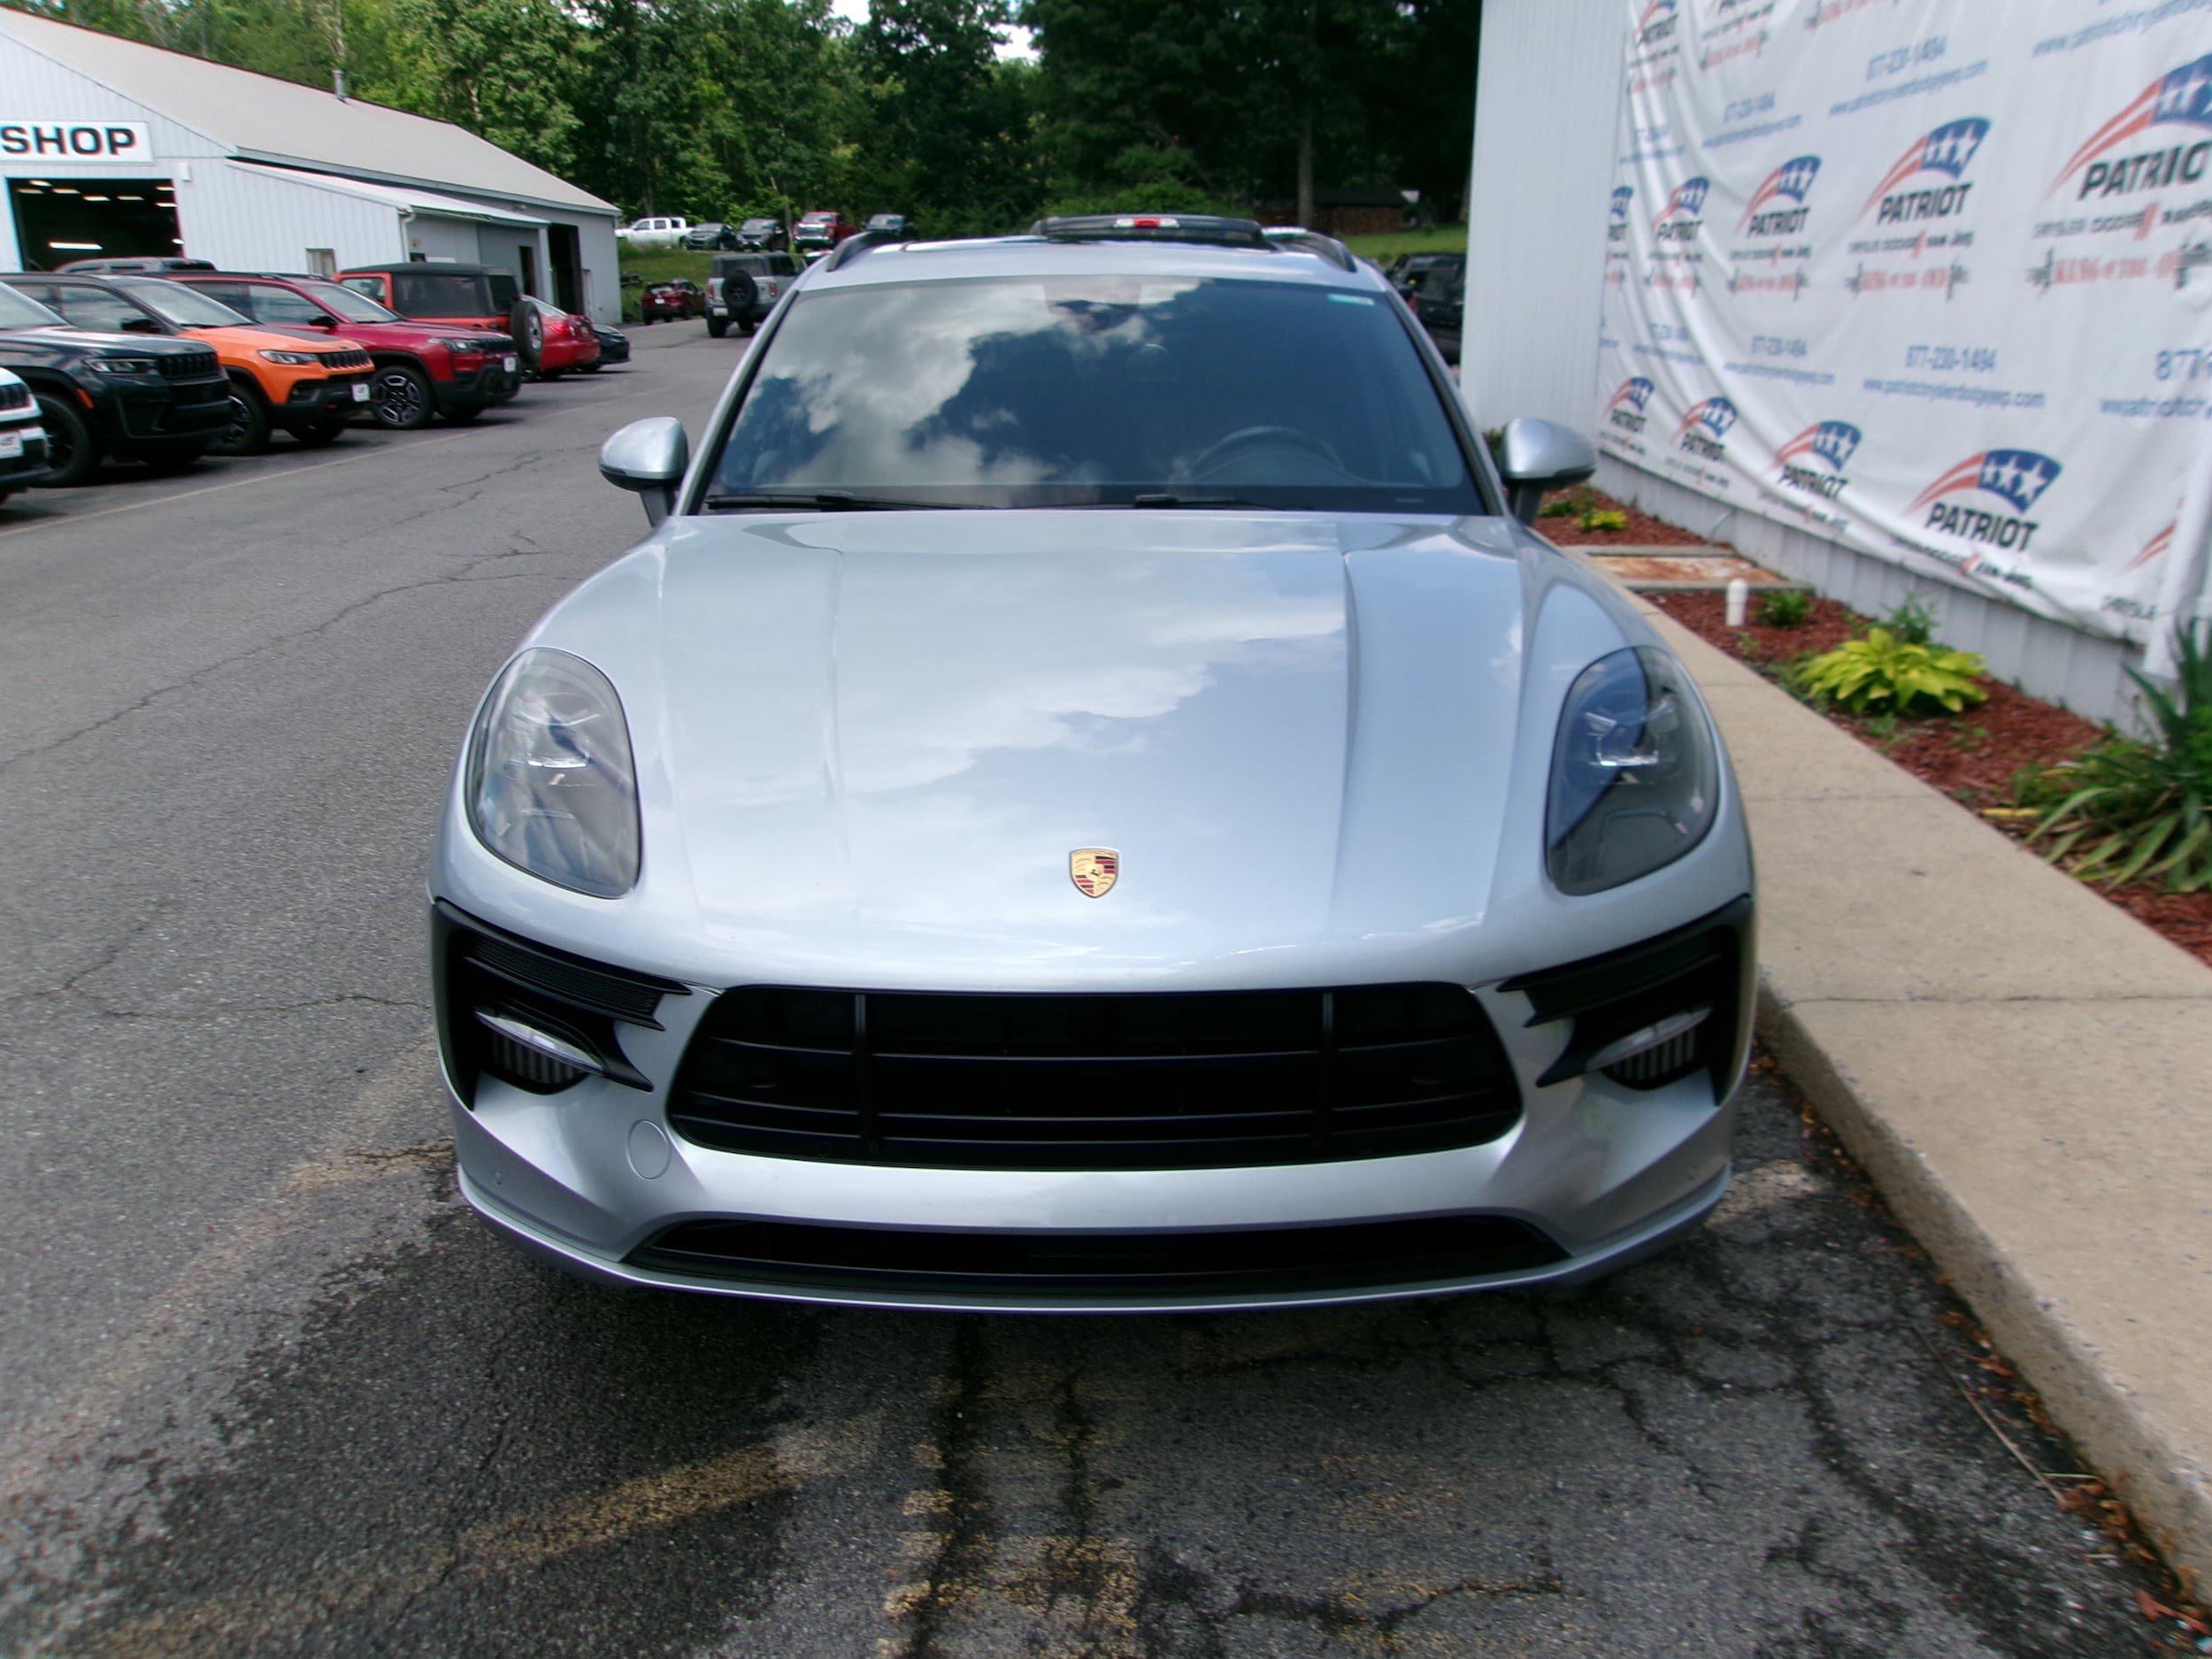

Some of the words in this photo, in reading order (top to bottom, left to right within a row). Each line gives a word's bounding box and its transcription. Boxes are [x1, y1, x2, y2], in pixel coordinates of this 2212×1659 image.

[0, 126, 137, 156] SHOP
[2077, 141, 2212, 201] PATRIO
[1876, 181, 1974, 225] PATRIOT
[1656, 220, 1703, 241] PATRIOT
[1747, 207, 1811, 237] PATRIOT
[1777, 464, 1849, 500] PATRIOT
[1924, 502, 2039, 552] PATRIOT
